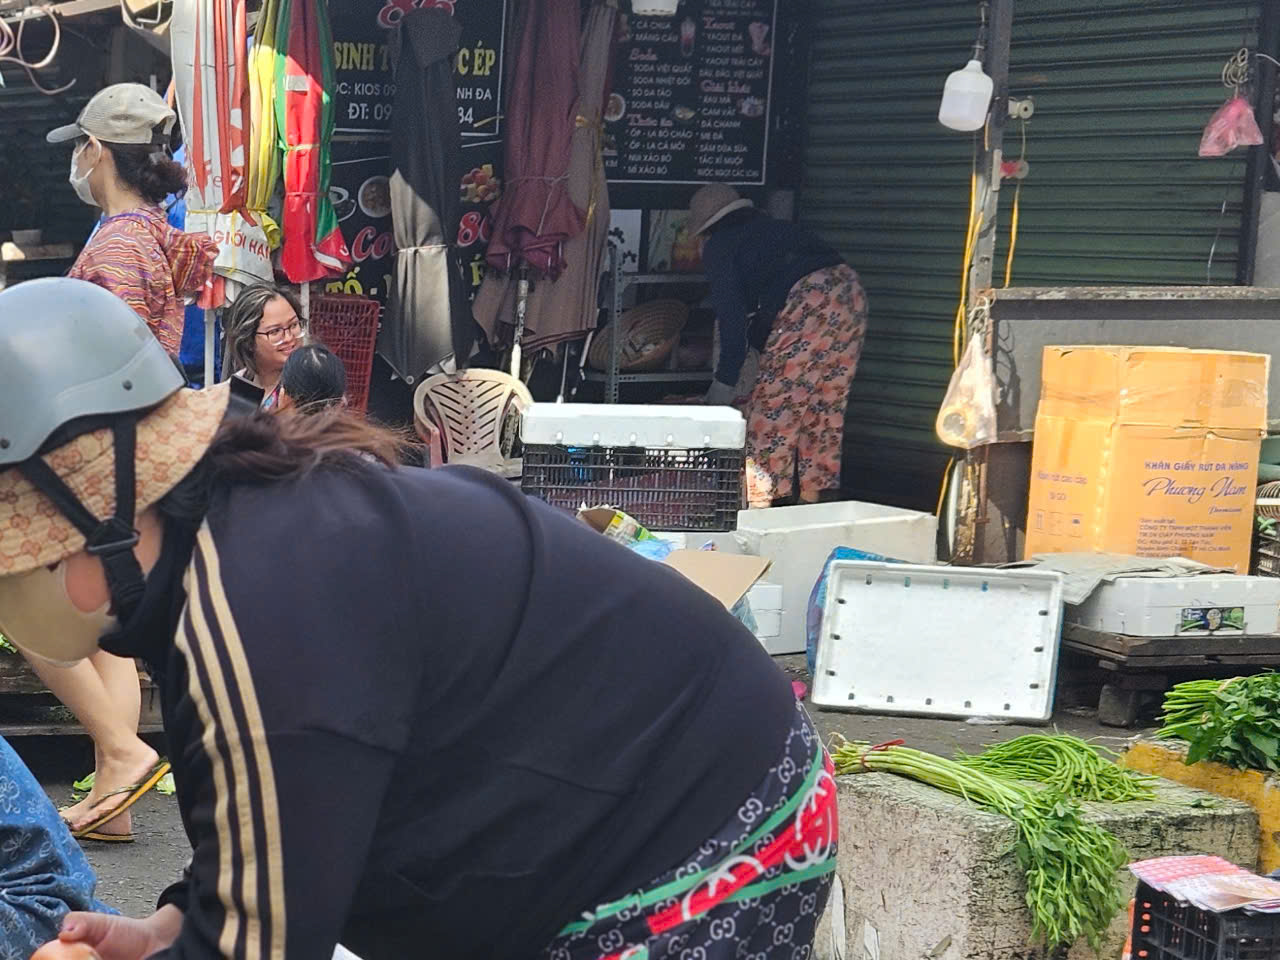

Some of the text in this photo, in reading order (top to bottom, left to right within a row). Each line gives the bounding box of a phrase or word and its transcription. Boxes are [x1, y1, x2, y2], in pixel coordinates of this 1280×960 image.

[334, 41, 376, 71] SINH
[472, 40, 496, 76] ÉP
[354, 83, 381, 96] KIOS
[475, 88, 493, 101] ĐA
[348, 102, 369, 120] ĐT:
